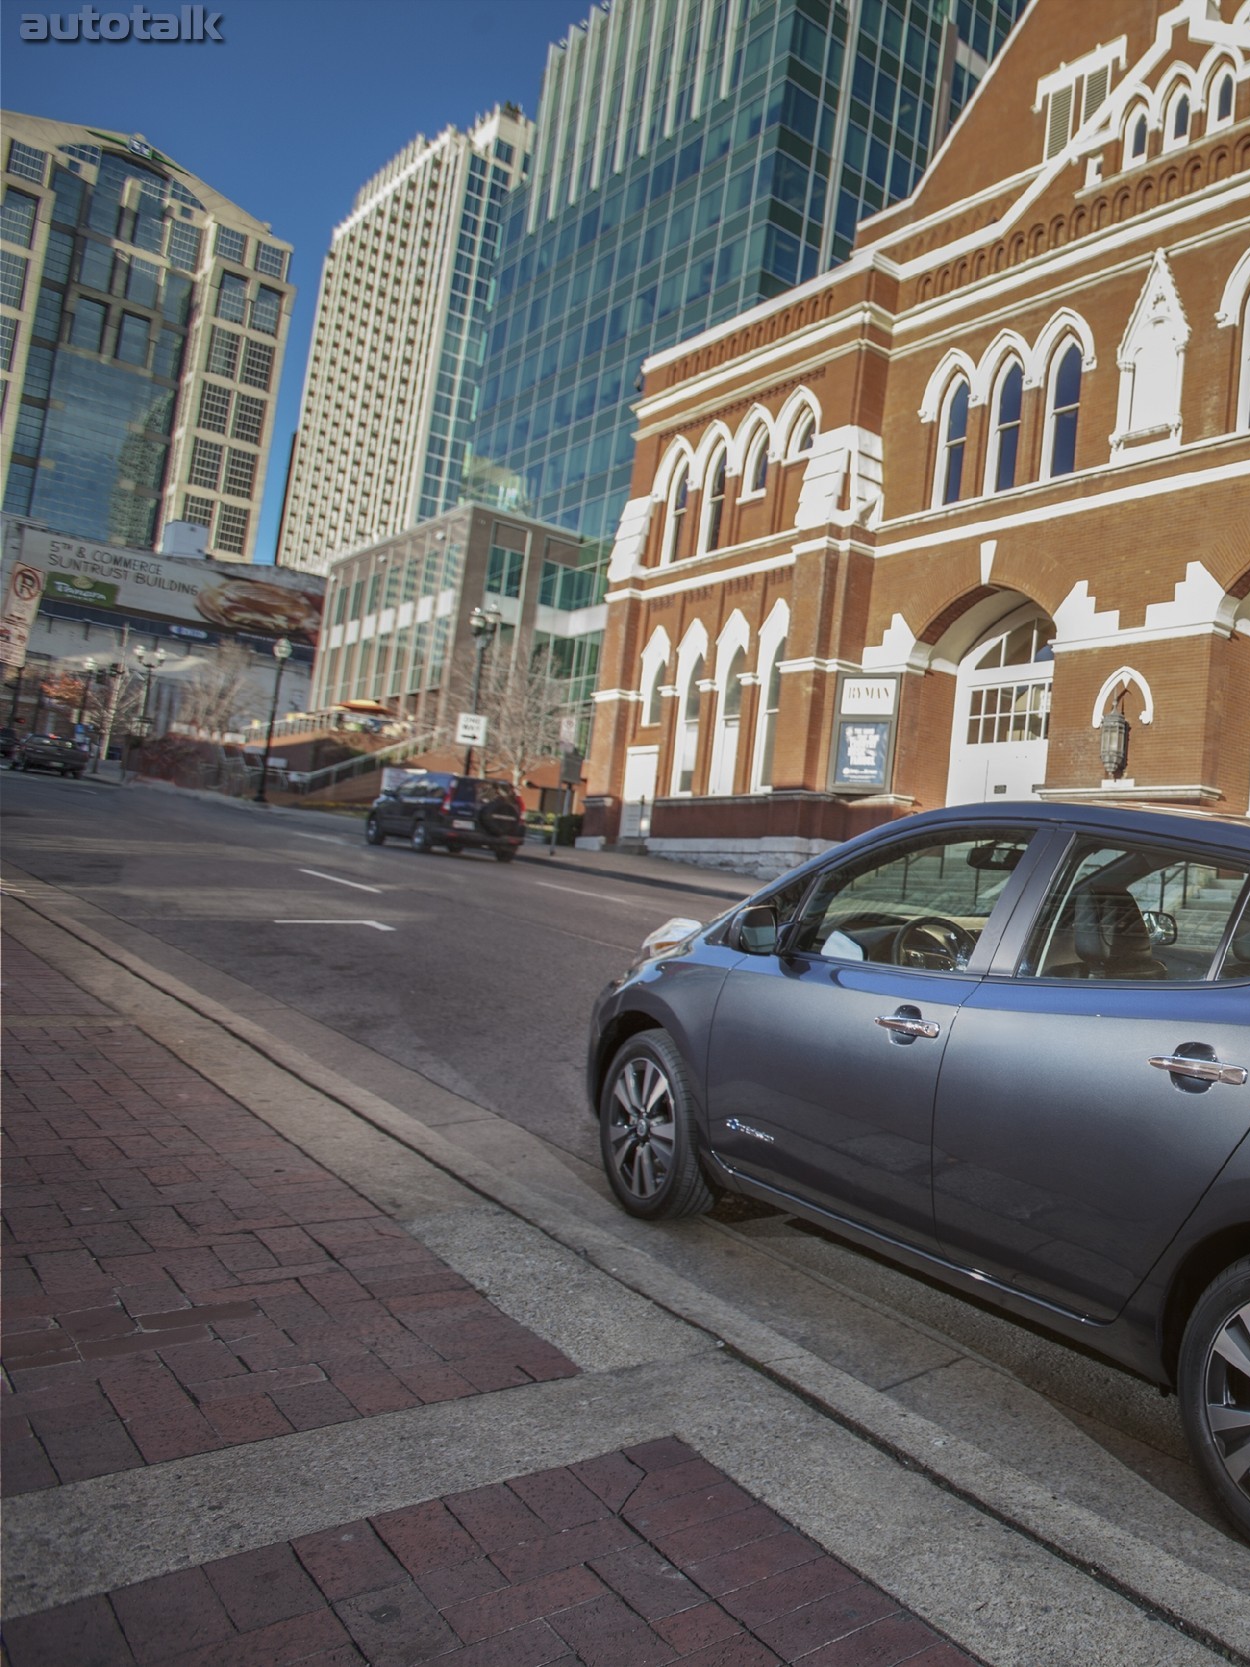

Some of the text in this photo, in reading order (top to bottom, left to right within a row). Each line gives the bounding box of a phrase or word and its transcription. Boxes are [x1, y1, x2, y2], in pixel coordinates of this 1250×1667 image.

[48, 553, 200, 597] SUNTRUST BUILDING
[76, 546, 86, 559] &
[92, 550, 164, 576] COMMERCE
[848, 687, 890, 699] RYMAN
